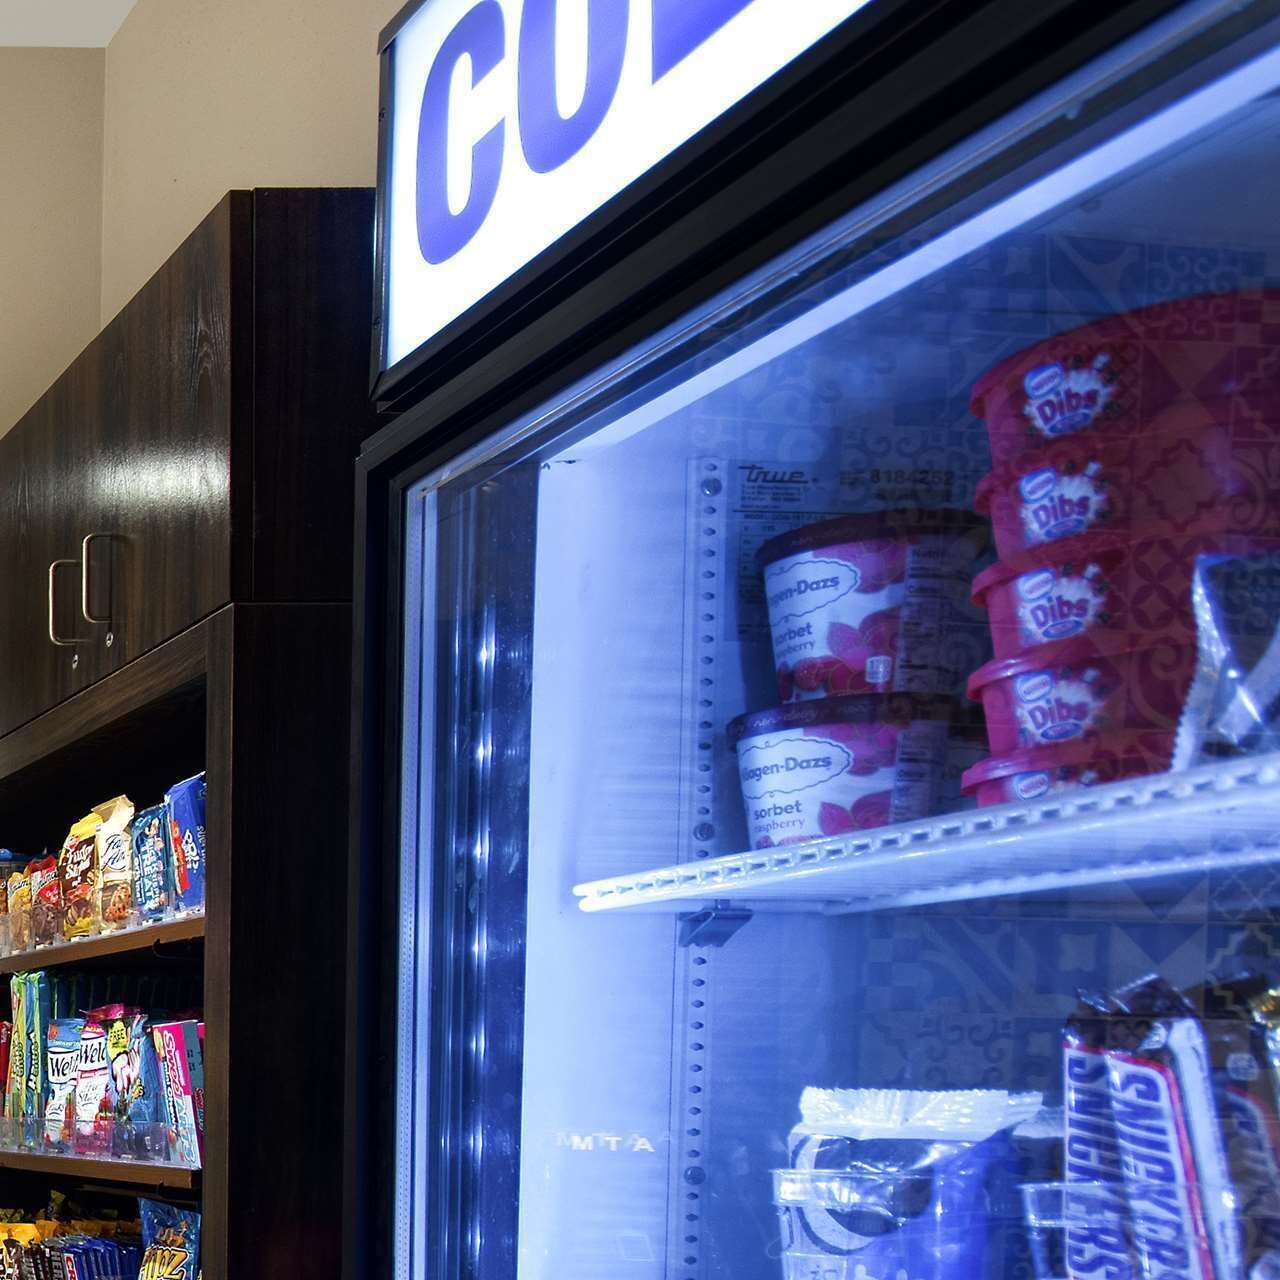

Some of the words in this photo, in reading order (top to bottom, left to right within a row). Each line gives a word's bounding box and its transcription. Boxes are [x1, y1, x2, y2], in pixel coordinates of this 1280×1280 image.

[1036, 387, 1099, 421] Dibs
[1031, 493, 1091, 530] Dibs
[767, 573, 840, 603] gen-Dazs
[1030, 595, 1089, 630] Dibs
[1028, 699, 1089, 734] Dibs
[753, 801, 802, 821] sorbet
